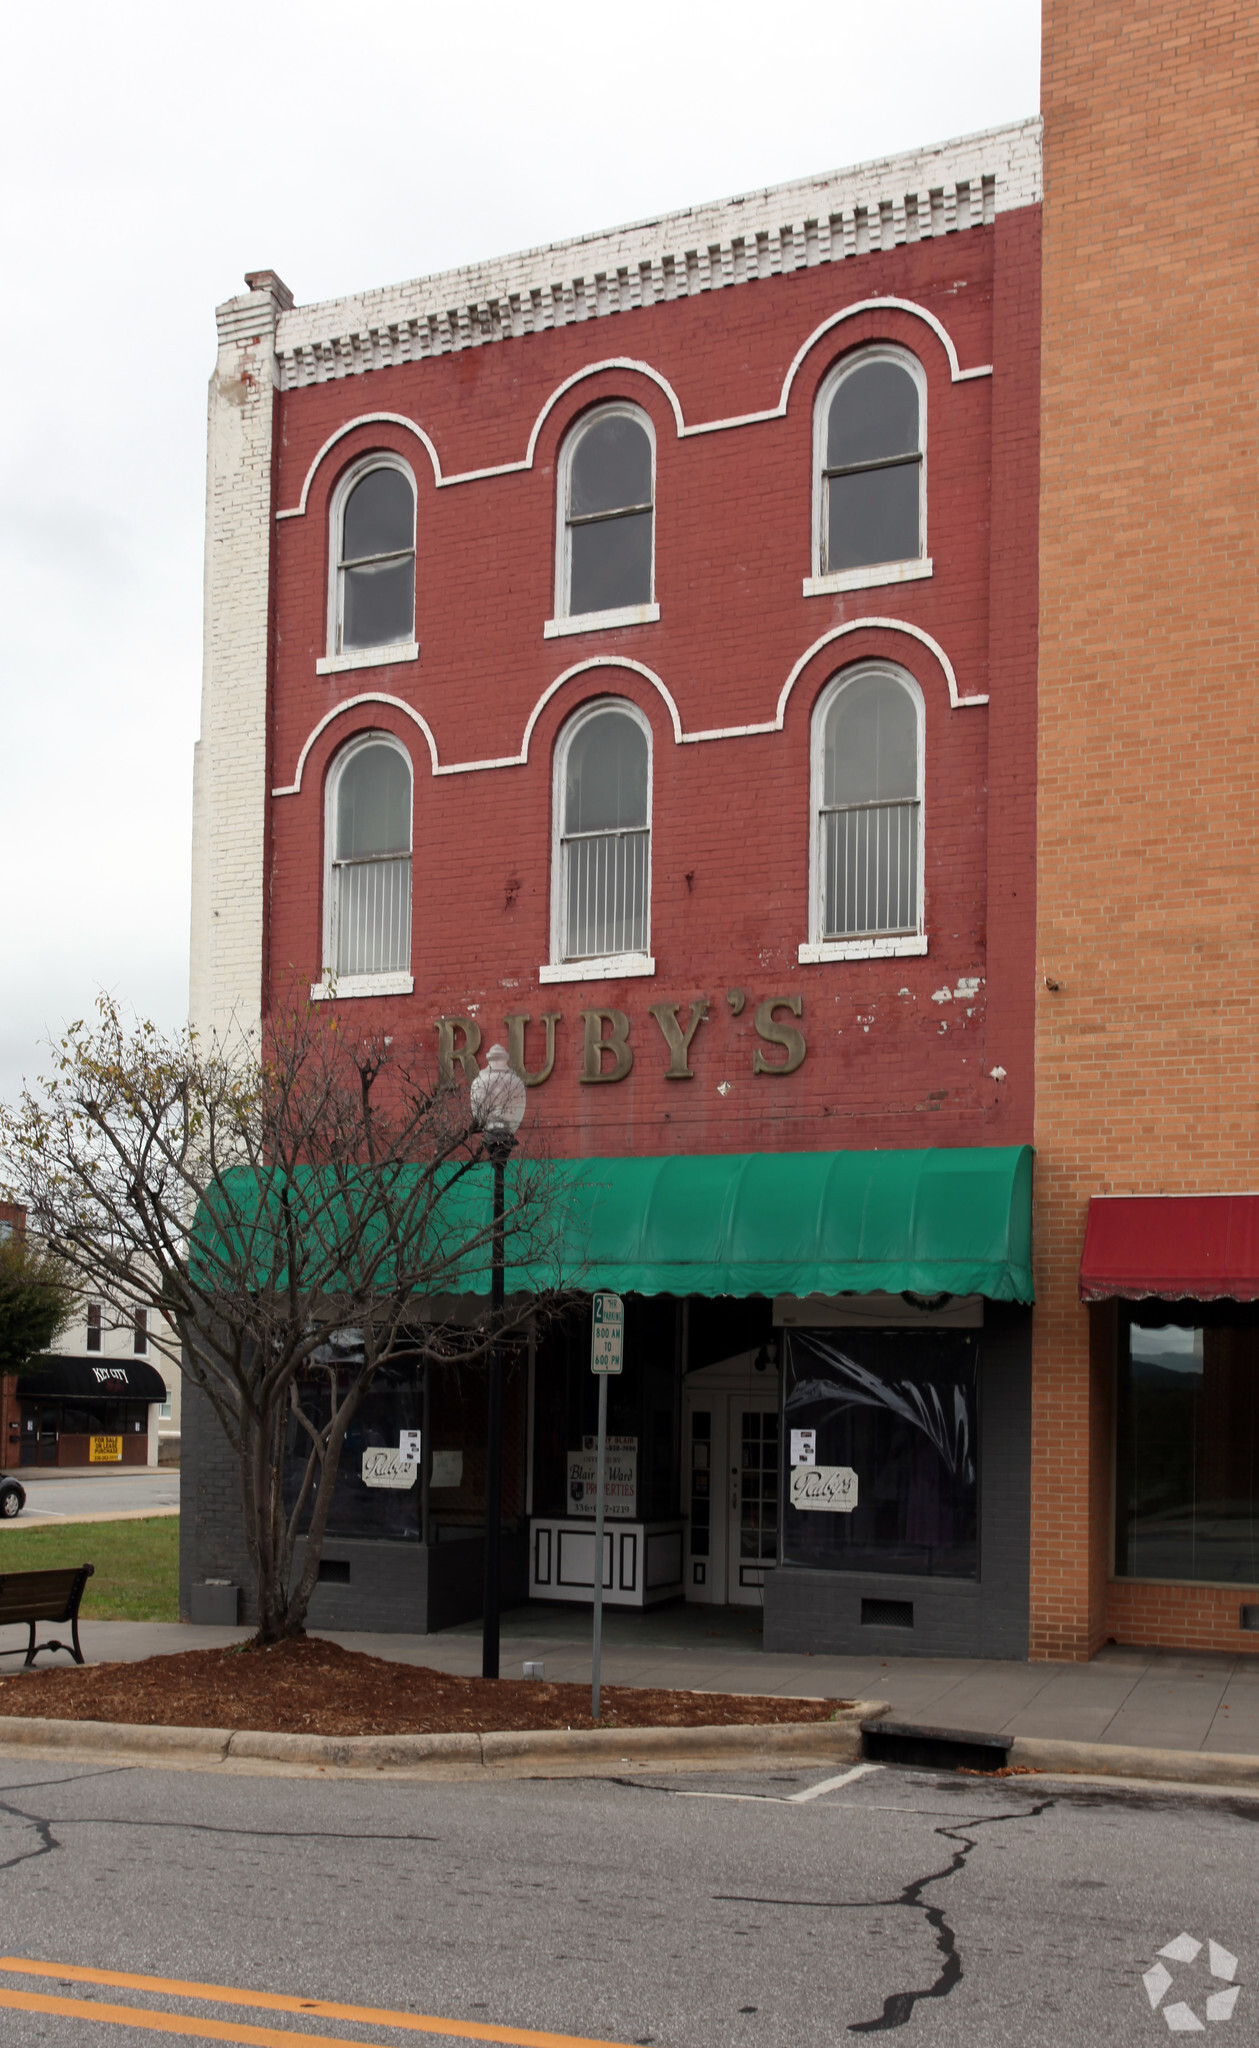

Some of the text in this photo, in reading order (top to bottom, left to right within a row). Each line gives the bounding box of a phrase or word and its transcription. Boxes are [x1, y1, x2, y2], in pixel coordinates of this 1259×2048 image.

[433, 988, 807, 1090] RUBY'S
[596, 1297, 602, 1318] 2
[603, 1310, 622, 1321] PARKING
[611, 1328, 621, 1339] AM
[604, 1341, 612, 1352] TO
[611, 1355, 620, 1365] PM
[92, 1367, 129, 1384] KEY CITY
[570, 1464, 633, 1482] Blair Ward
